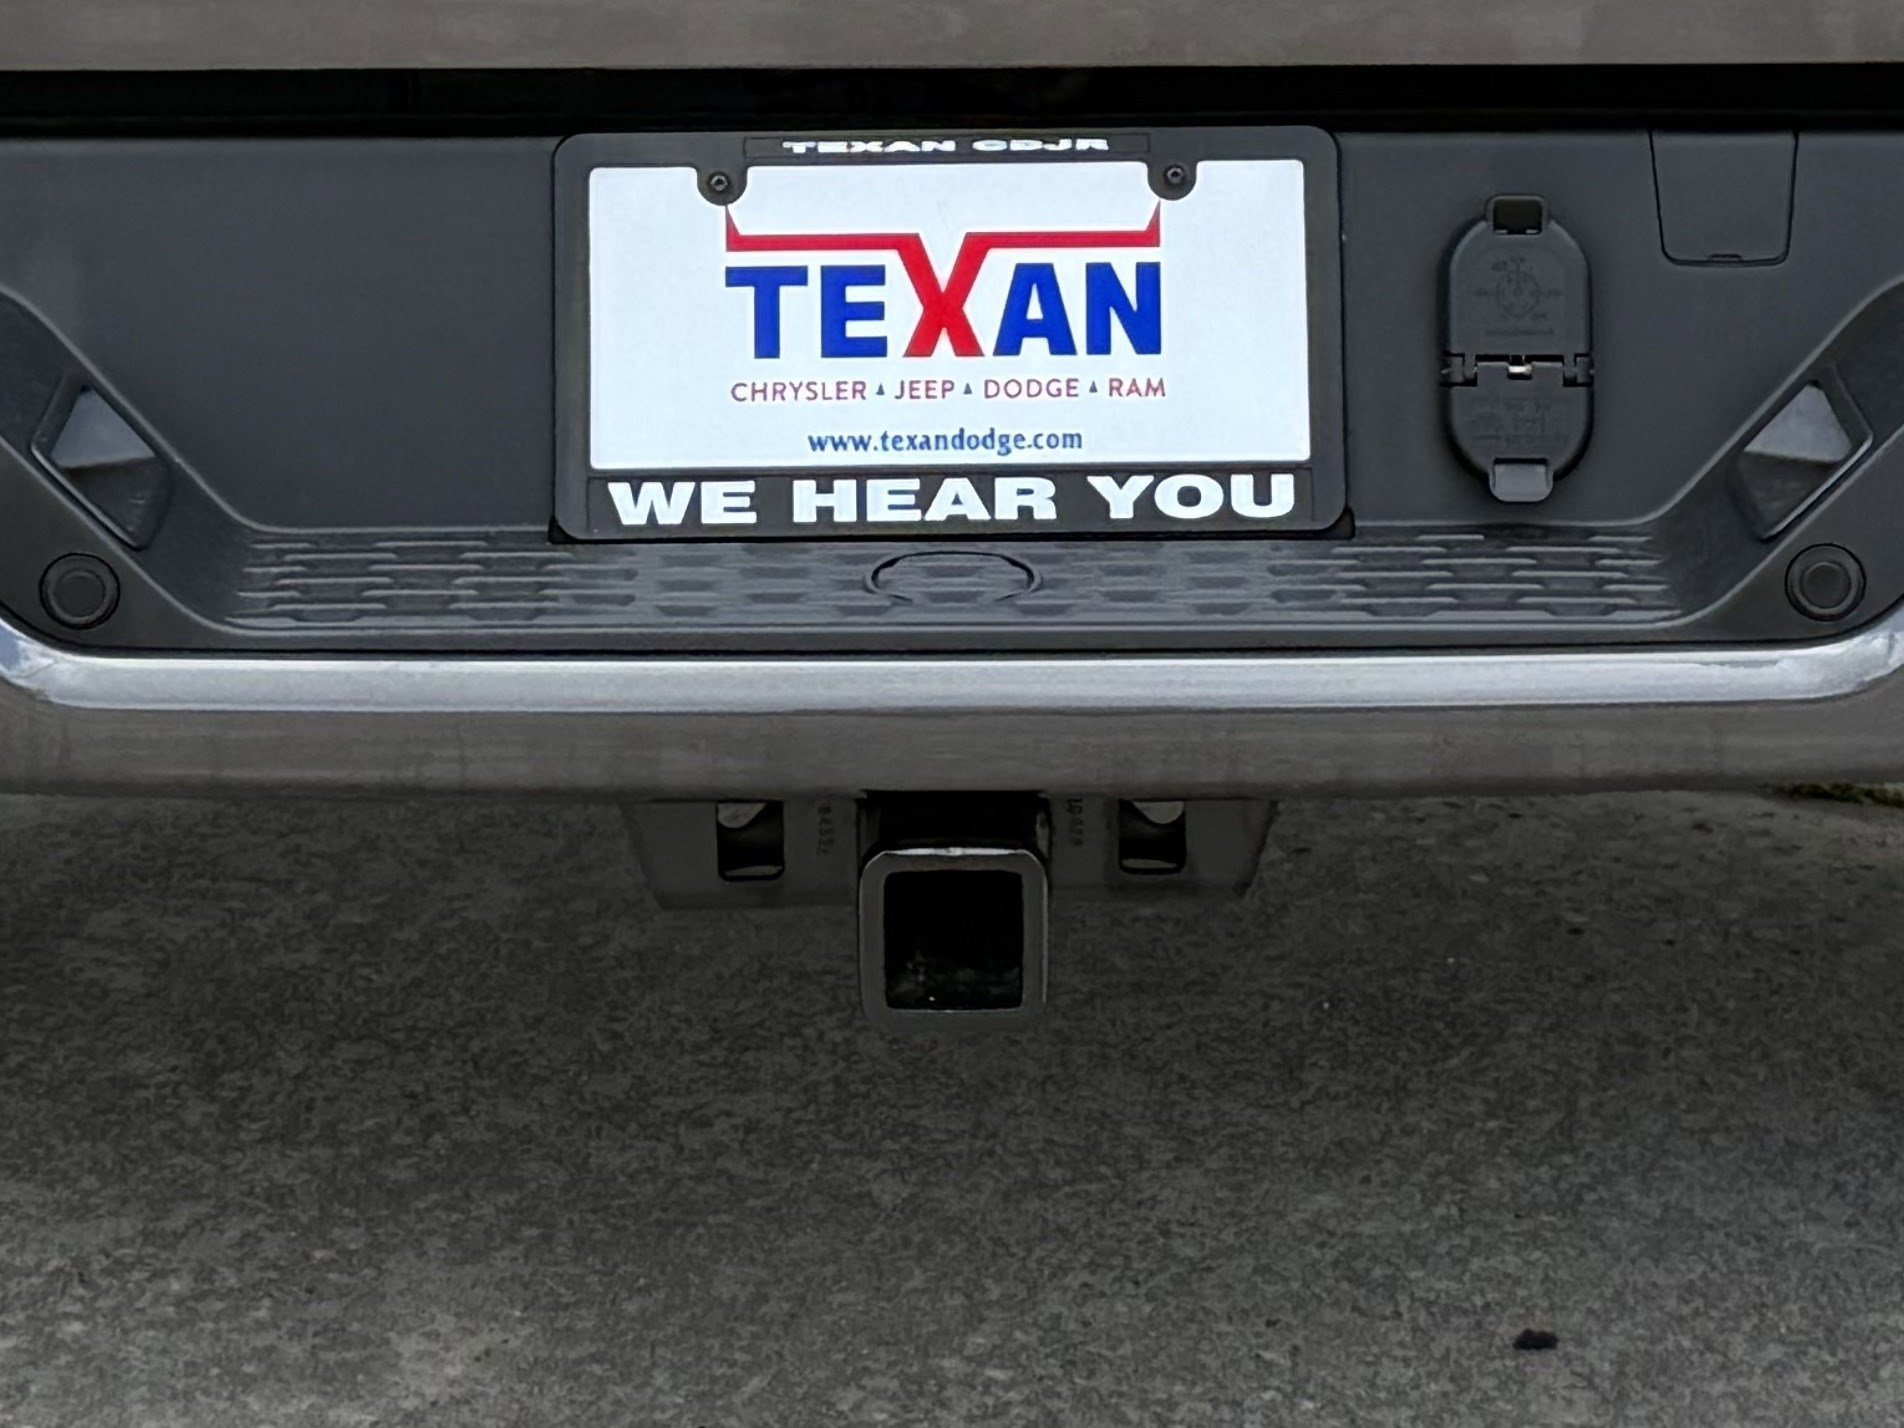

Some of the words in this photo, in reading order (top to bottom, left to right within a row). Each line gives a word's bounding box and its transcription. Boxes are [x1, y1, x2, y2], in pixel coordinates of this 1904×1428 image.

[782, 139, 956, 154] TEXAN
[724, 231, 1163, 359] TEXAN
[730, 379, 867, 402] CHRYSLER
[894, 379, 956, 401] JEEP
[983, 377, 1080, 400] DODGE
[1108, 377, 1167, 398] RAM
[807, 428, 1083, 457] www.texandodge.com
[607, 481, 758, 527] WE
[791, 477, 1057, 524] HEAR
[1086, 473, 1296, 520] YOU
